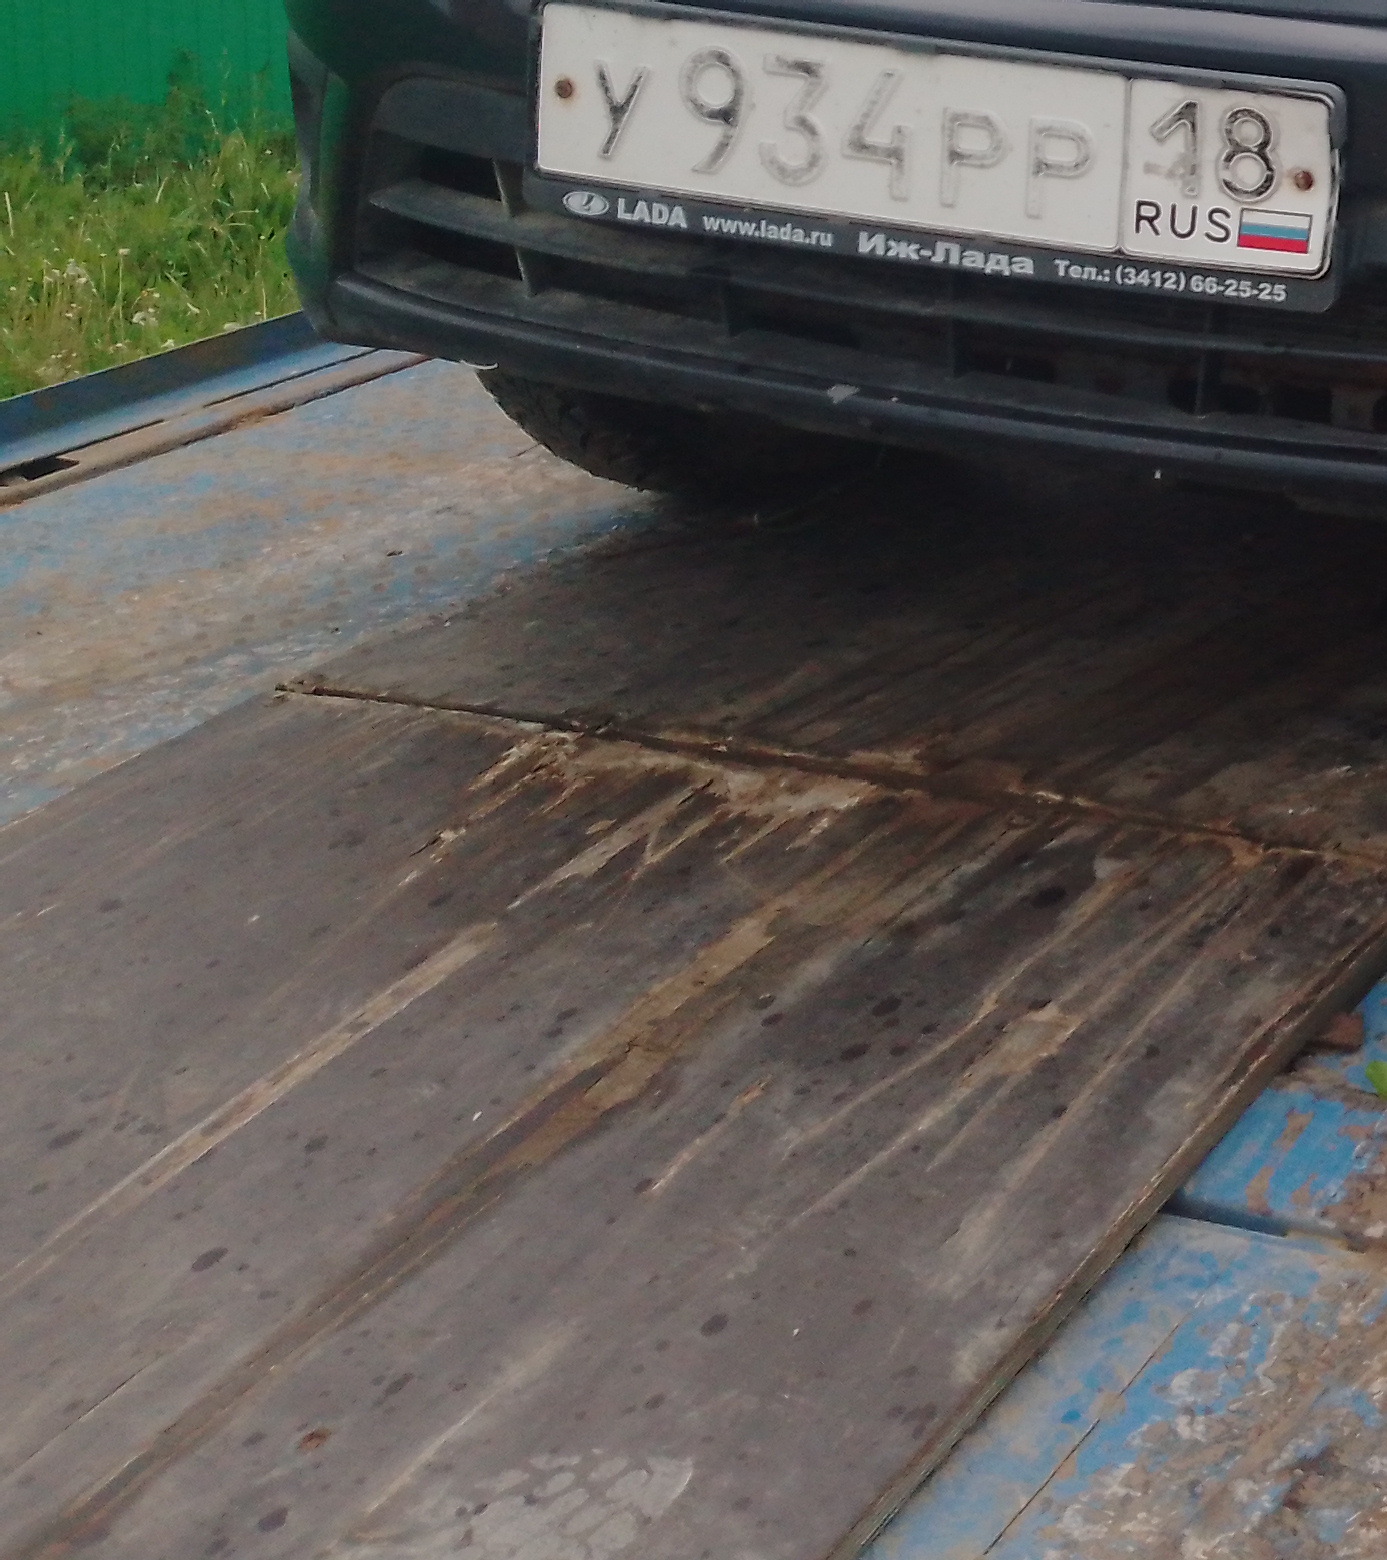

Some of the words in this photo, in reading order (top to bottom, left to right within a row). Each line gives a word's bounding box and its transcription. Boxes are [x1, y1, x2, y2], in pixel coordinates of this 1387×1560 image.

[1150, 100, 1278, 203] 18
[616, 197, 688, 229] LADA
[702, 214, 835, 247] www.lada.ru
[1135, 200, 1232, 244] RUS
[858, 230, 1034, 277] Иж-Лада
[1054, 258, 1111, 283] Тел.:
[1115, 263, 1187, 292] (3412)
[1190, 274, 1288, 303] 66-25-25
